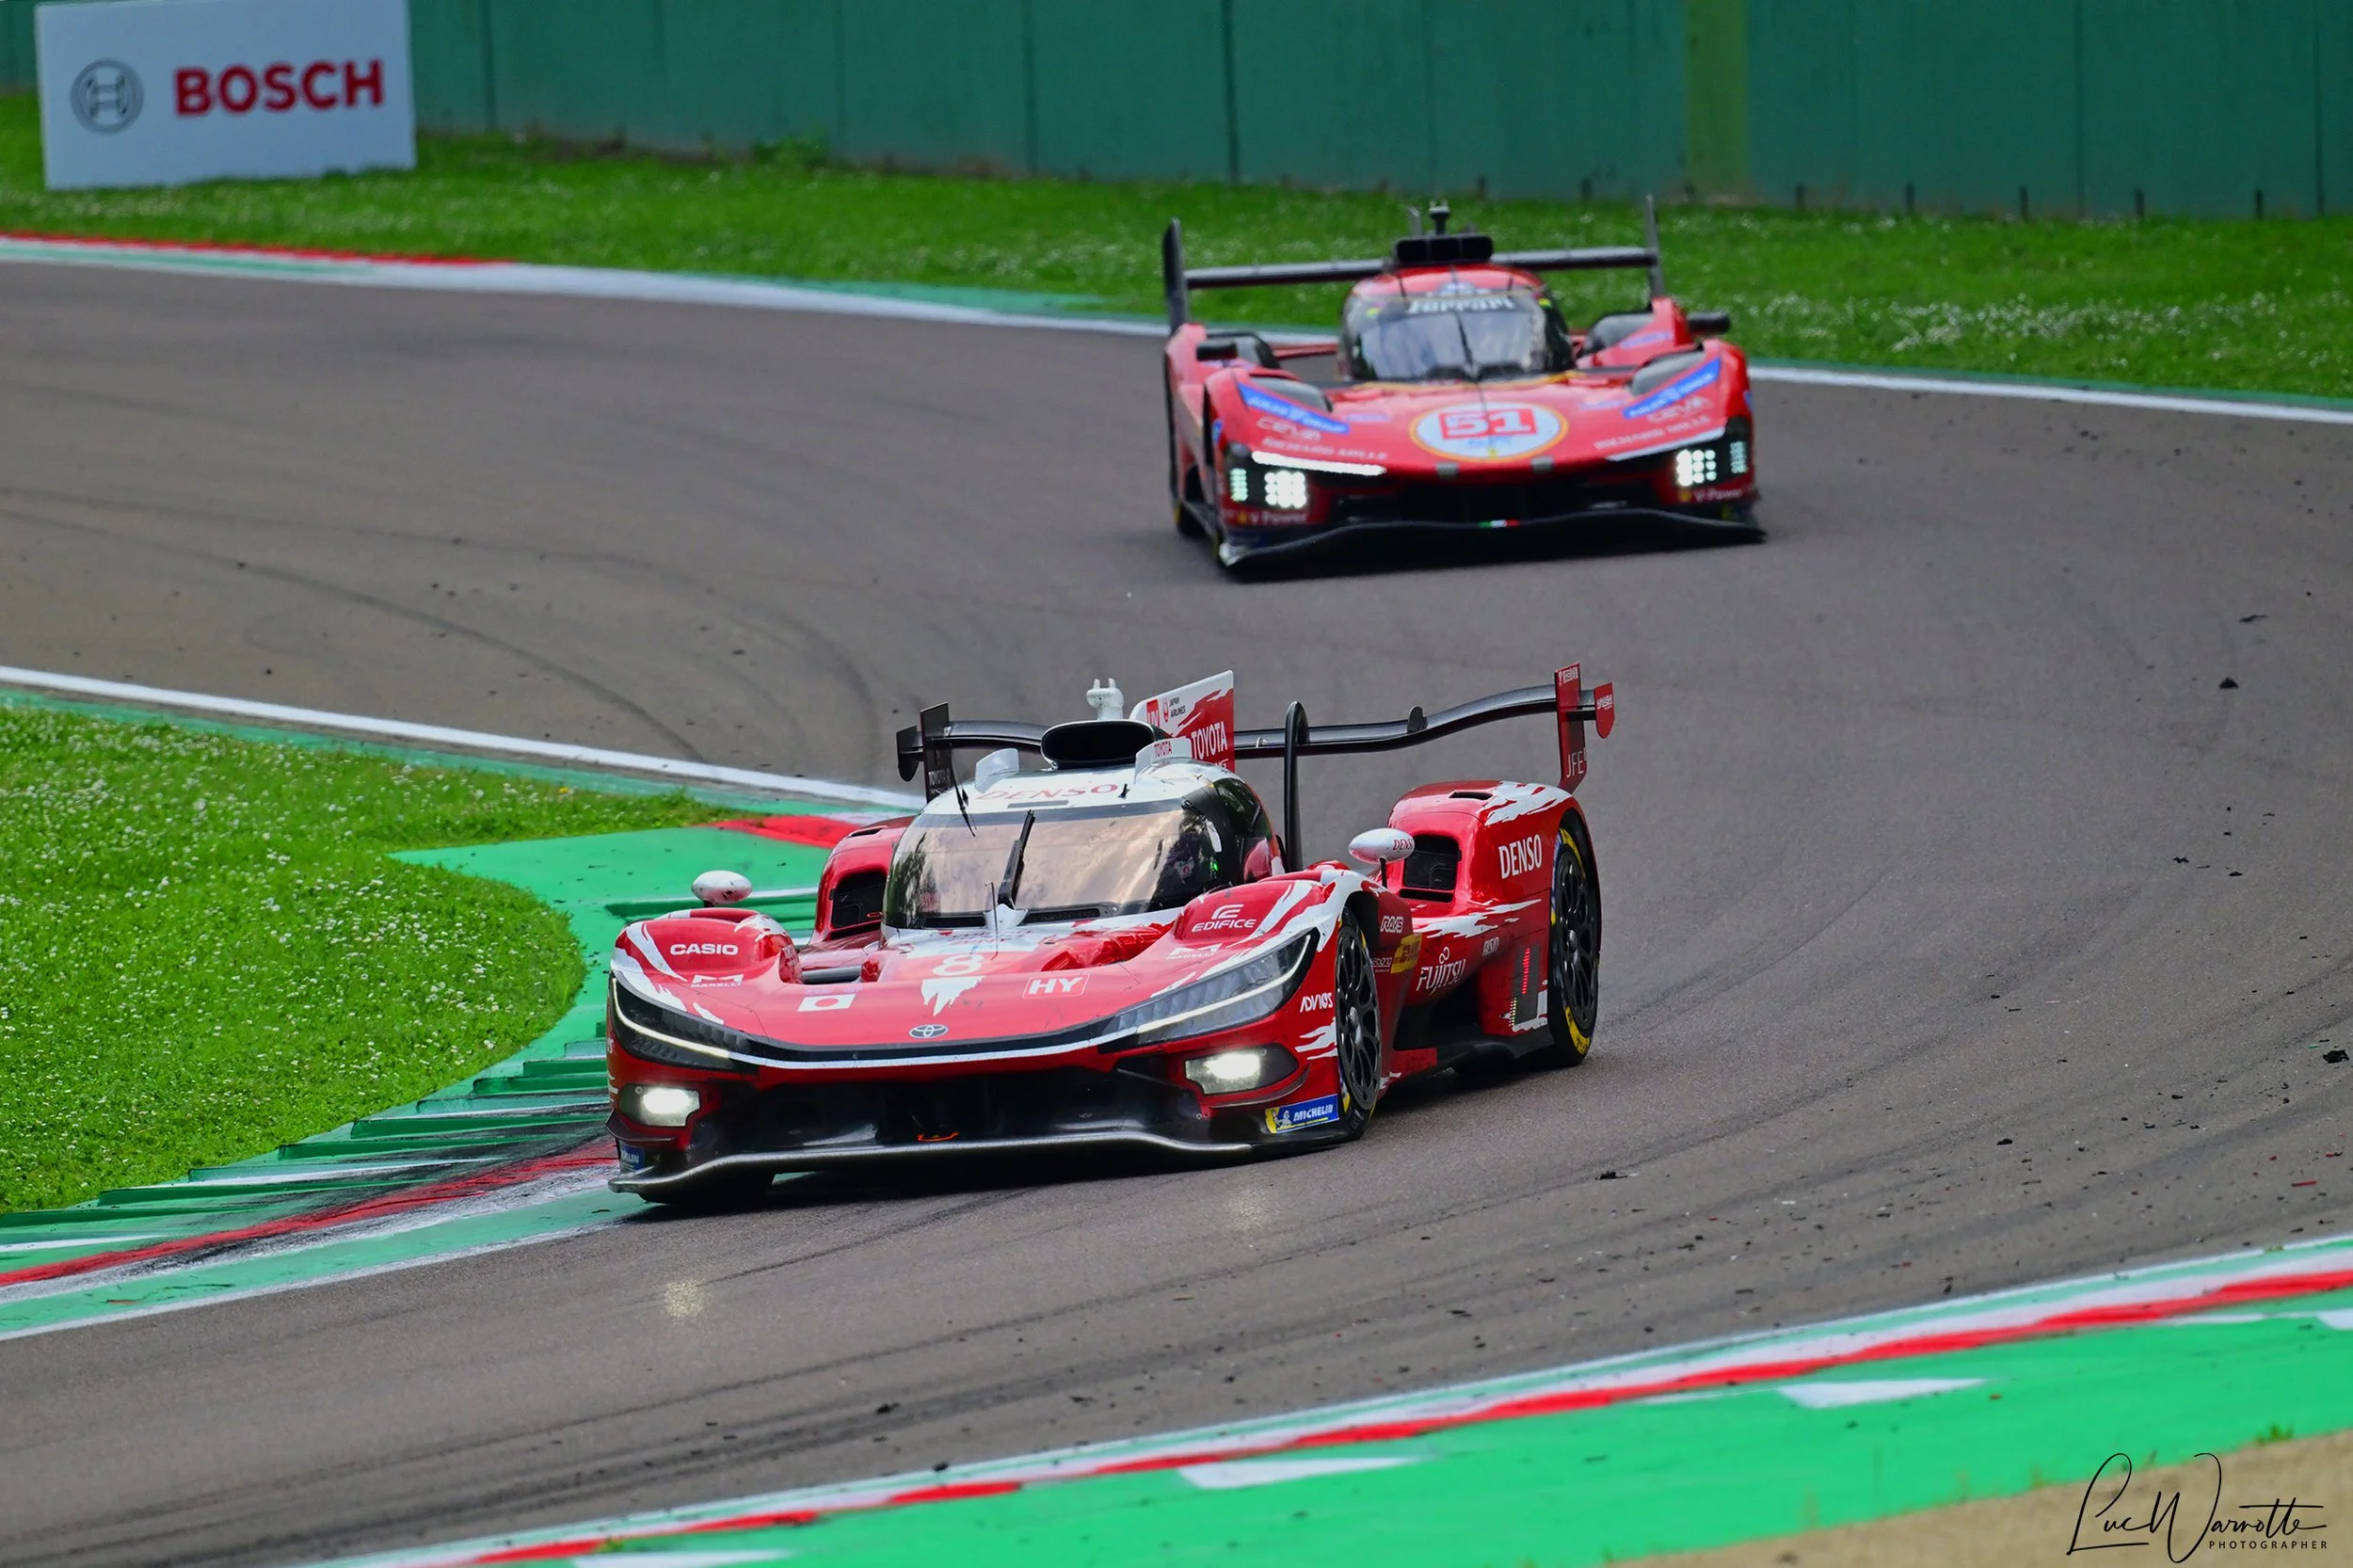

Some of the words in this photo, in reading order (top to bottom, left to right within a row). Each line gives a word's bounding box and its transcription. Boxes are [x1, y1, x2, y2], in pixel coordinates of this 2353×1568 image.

[173, 59, 384, 117] BOSCH
[1407, 296, 1516, 314] Ferrari
[1445, 408, 1533, 437] 51
[1169, 696, 1180, 708] JAPAN
[1170, 706, 1186, 717] AIRLINES
[1154, 741, 1173, 758] TOYOTA
[1191, 721, 1227, 760] TOYOTA
[976, 783, 1118, 800] DENSO
[1498, 834, 1543, 879] DENSO
[1192, 919, 1257, 933] EDIFICE
[669, 943, 739, 955] CASIO
[933, 953, 984, 976] 8
[691, 980, 742, 988] MARELLI
[1028, 977, 1083, 995] HY
[1416, 959, 1465, 996] FUJITSU
[1293, 1104, 1334, 1122] MICHELIN
